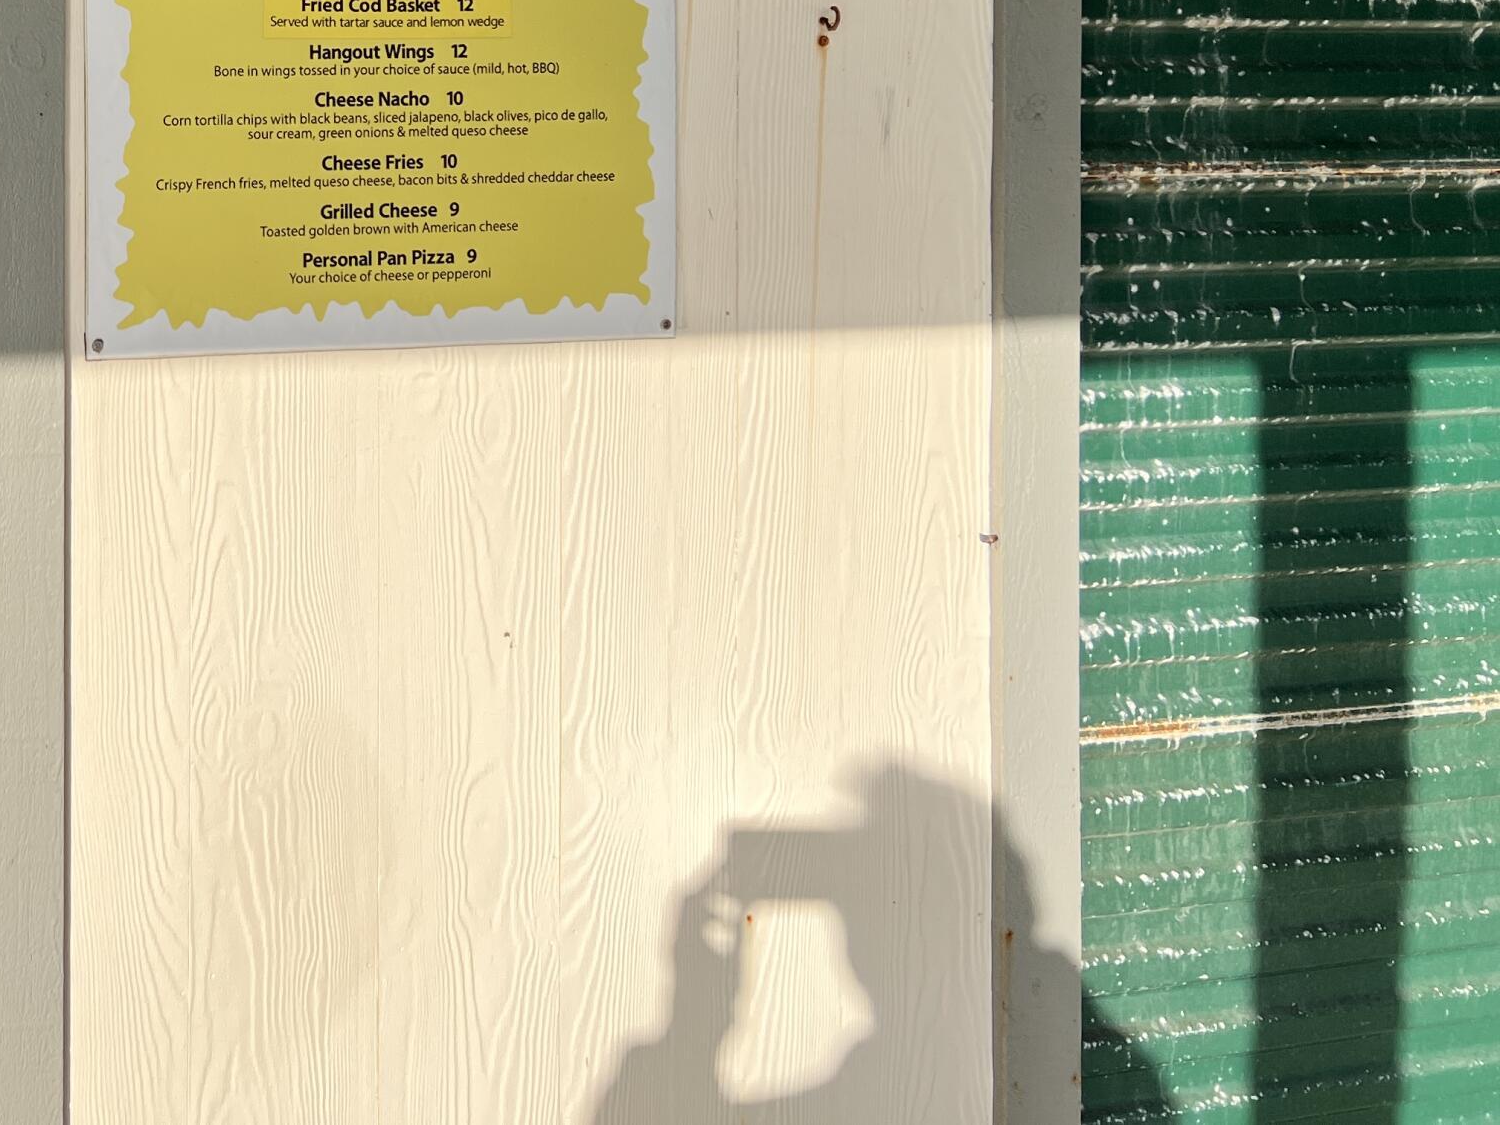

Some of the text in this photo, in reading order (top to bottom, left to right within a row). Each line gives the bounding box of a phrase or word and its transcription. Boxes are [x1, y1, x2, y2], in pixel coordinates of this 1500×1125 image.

[270, 15, 505, 30] Served with tartar sauce and lemon wedge
[309, 43, 468, 64] Hangout Wings 12
[214, 62, 560, 80] Bone in wings tossed in your choice of sauce (mild, hot, BBQ)
[314, 90, 464, 108] Cheese Nacho 10
[163, 108, 608, 128] Corn tortilla chips with black beans, sliced jalapeno, black olives, pico de gallo,
[321, 153, 458, 171] Cheese Fries 10
[156, 170, 615, 193] Crispy French fries, melted queso cheese, bacon bits & shredded cheddar cheese
[320, 201, 460, 220] Grilled Cheese 9
[260, 220, 519, 239] Toasted golden brown with American cheese
[302, 248, 477, 268] Personal Pan Pizza 9
[289, 267, 491, 284] Your choice of cheese or pepperoni
